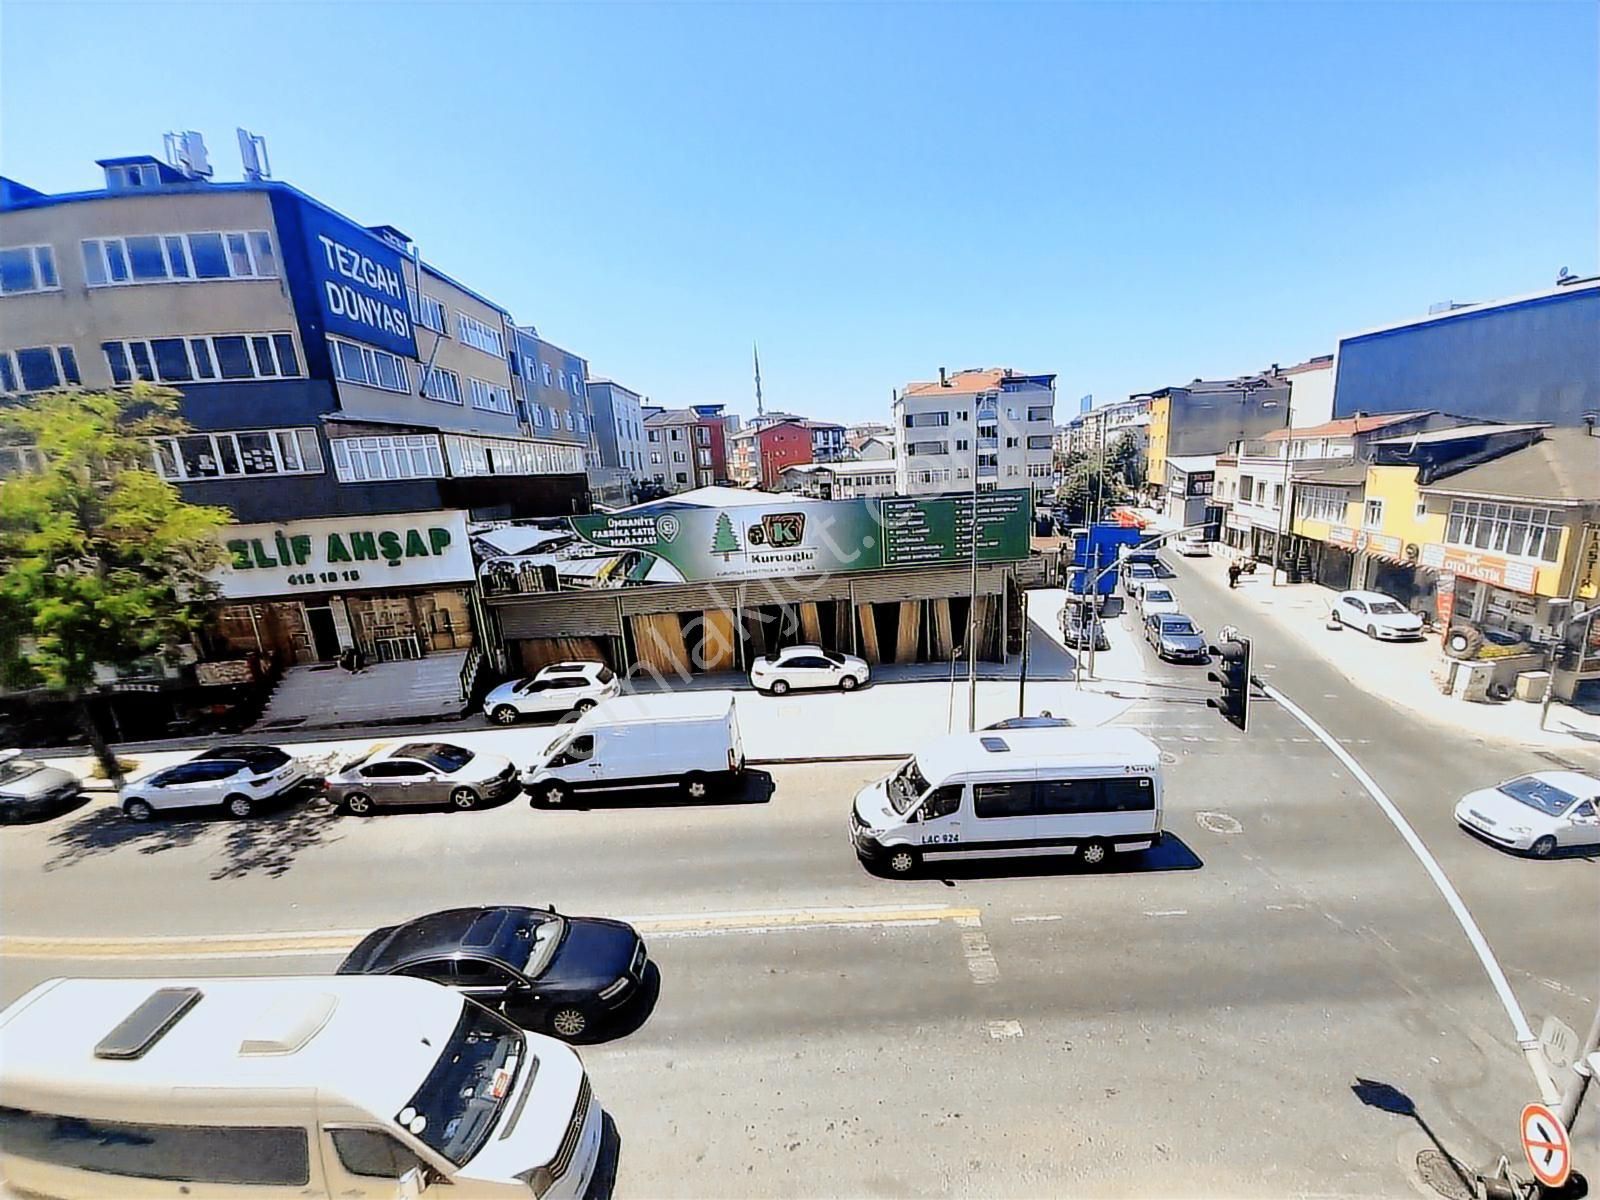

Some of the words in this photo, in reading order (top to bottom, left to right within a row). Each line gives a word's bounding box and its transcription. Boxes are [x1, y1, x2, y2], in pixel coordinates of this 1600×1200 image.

[318, 235, 402, 300] TEZGAH
[325, 281, 411, 340] DÜNYASI
[326, 527, 451, 567] AHŞAP
[751, 551, 814, 564] Kuruoğlu
[922, 835, 940, 843] LAC
